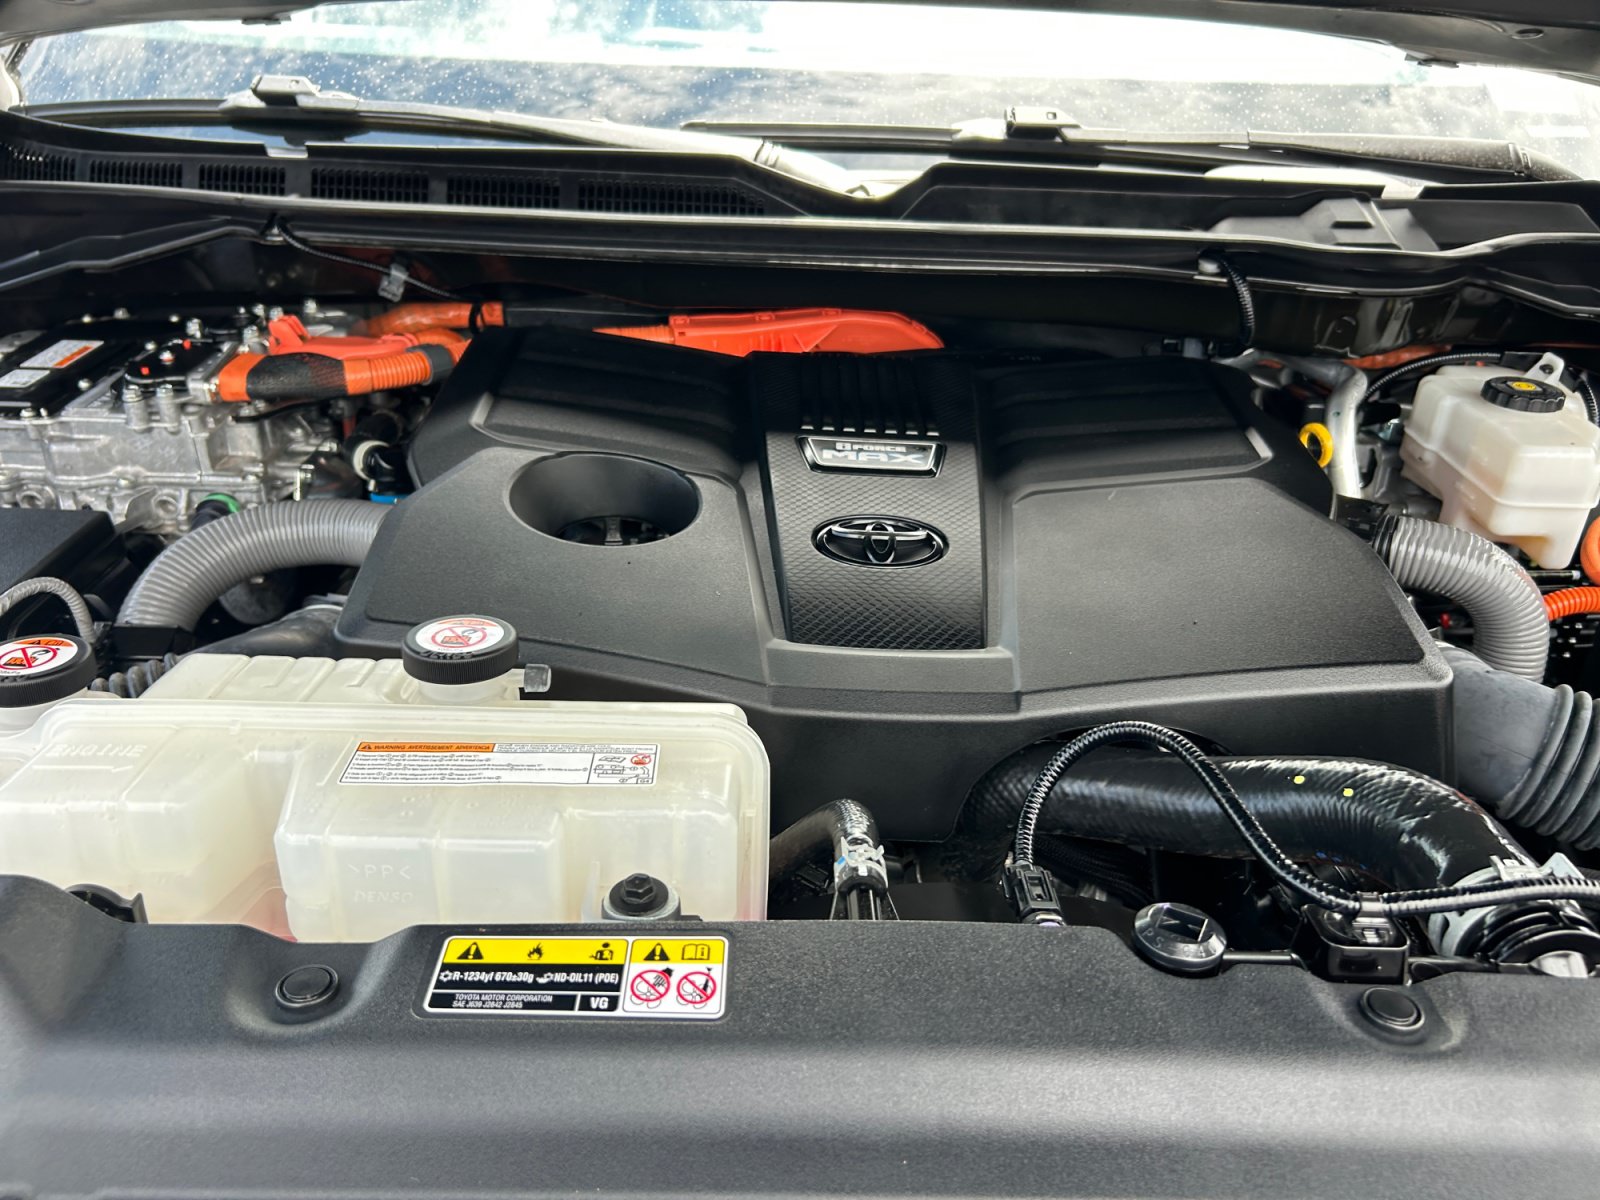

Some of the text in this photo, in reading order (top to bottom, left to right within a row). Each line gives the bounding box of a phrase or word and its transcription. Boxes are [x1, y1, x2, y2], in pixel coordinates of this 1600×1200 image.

[822, 449, 925, 464] MAX
[452, 971, 619, 985] R-1234yf 670±30g ND-OIL11 (POE)
[452, 1000, 466, 1008] SAE
[455, 993, 553, 1003] TOYOTA MOTOR CORPORATION
[589, 996, 609, 1010] VG
